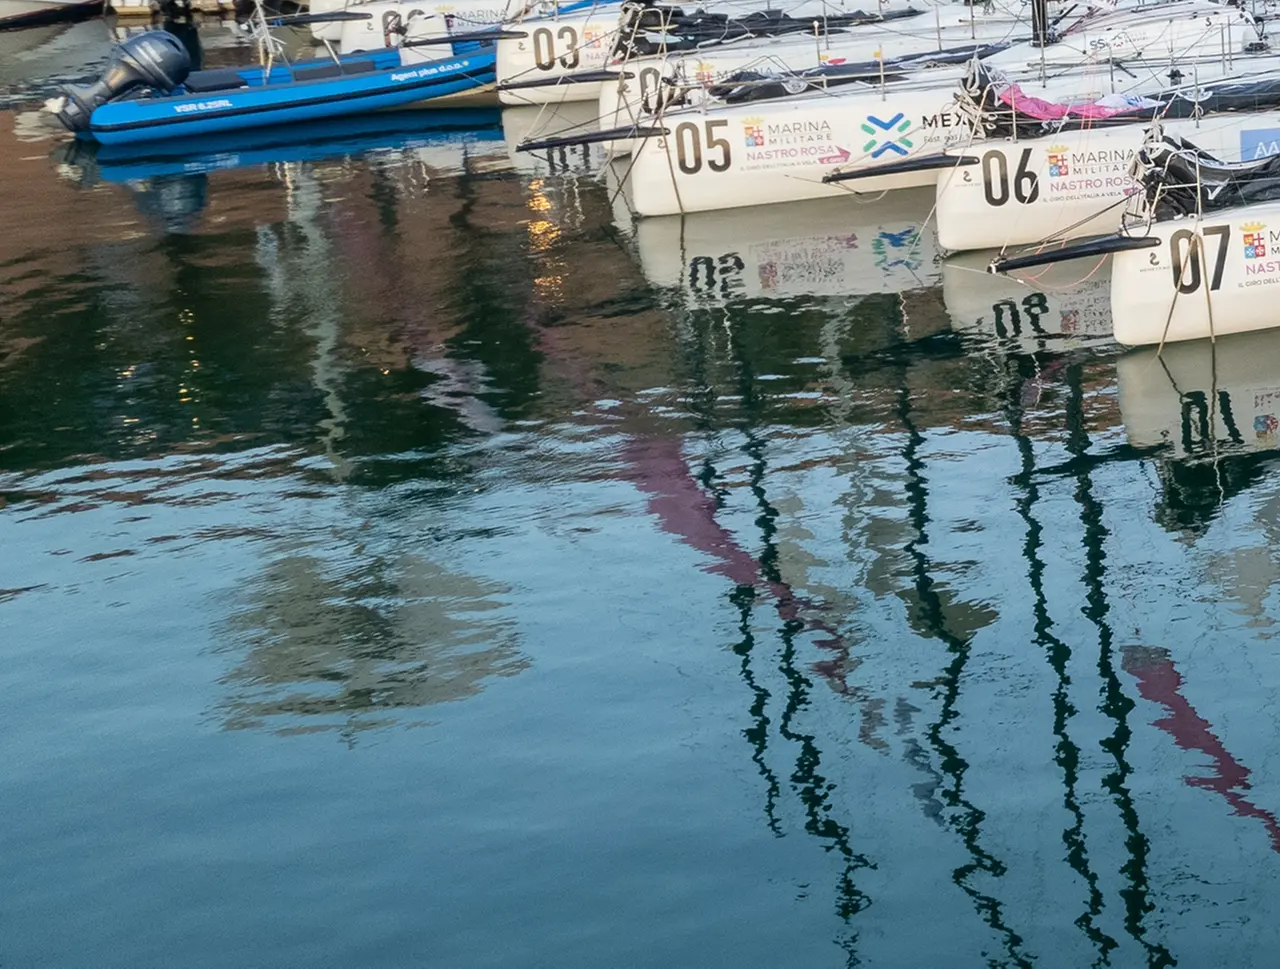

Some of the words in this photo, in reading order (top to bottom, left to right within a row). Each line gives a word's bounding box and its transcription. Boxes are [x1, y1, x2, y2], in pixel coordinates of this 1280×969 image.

[532, 25, 579, 71] 03
[391, 69, 418, 81] Agent
[419, 65, 437, 78] plus
[768, 120, 832, 135] MARINA
[676, 119, 732, 175] 05
[768, 134, 832, 145] MILITARE
[746, 147, 798, 161] NASTRO
[800, 144, 835, 156] ROSA
[981, 147, 1039, 207] 06
[1050, 178, 1103, 192] NASTRO
[1169, 224, 1231, 295] 07
[1244, 280, 1262, 288] GIRO
